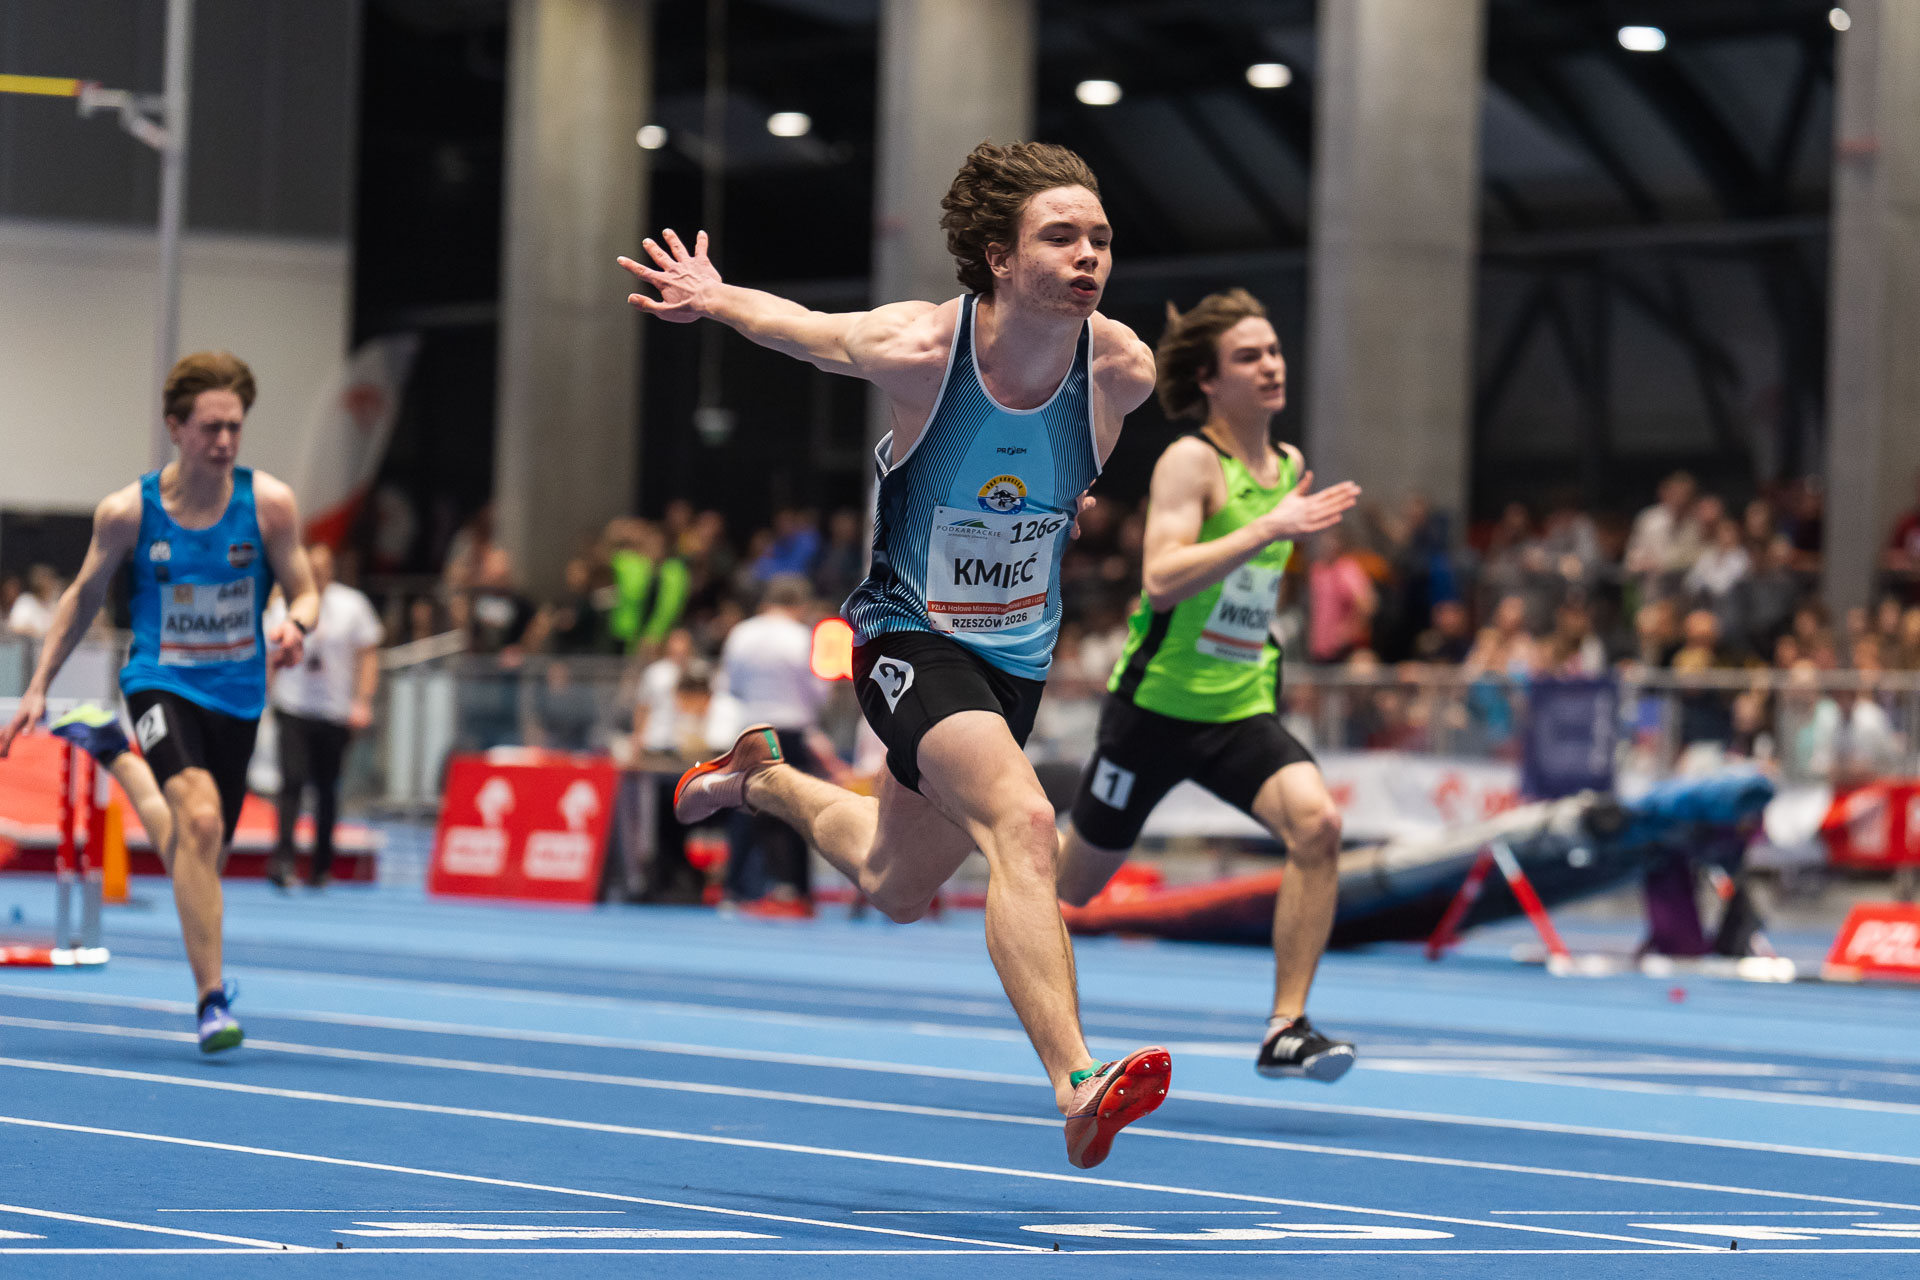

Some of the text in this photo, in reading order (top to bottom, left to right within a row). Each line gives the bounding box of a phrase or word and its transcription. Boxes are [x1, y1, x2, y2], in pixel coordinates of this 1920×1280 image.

[936, 525, 1001, 538] PODKARPACKIE
[954, 552, 1039, 588] KMIEĆ
[952, 612, 1028, 628] RZESZÓW 2026
[879, 663, 906, 698] 3
[143, 714, 158, 743] 2
[1106, 773, 1119, 799] 1
